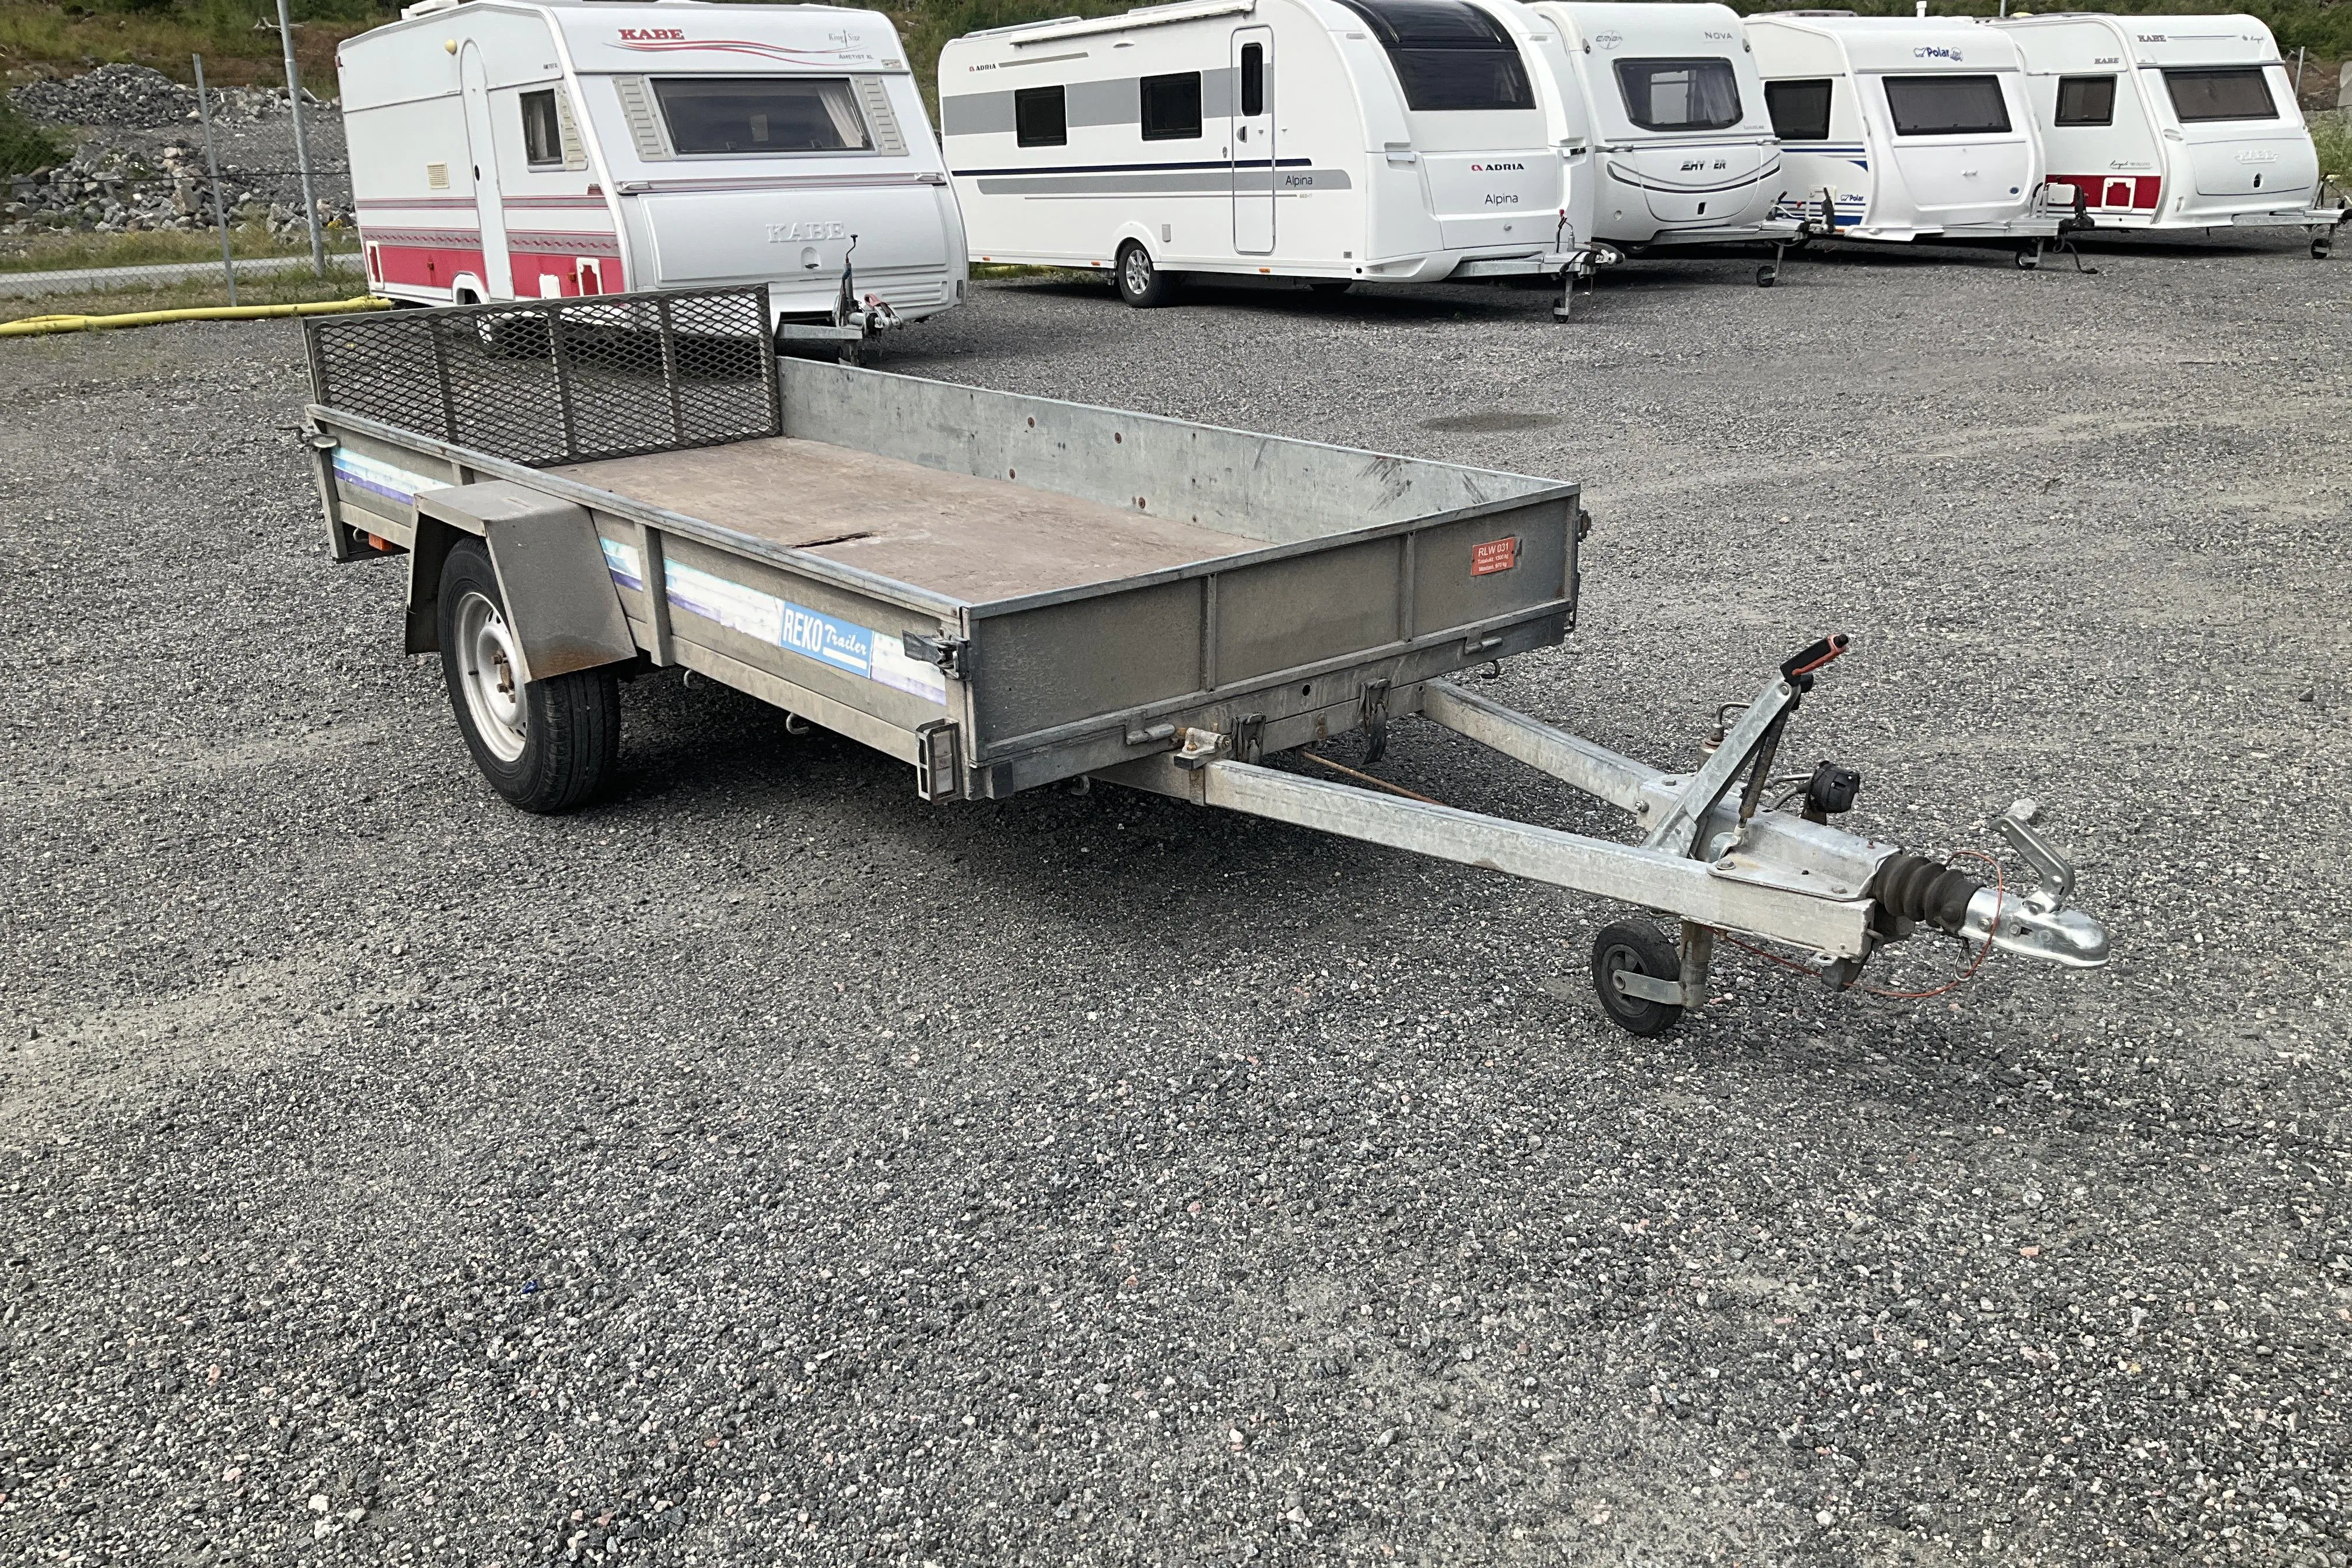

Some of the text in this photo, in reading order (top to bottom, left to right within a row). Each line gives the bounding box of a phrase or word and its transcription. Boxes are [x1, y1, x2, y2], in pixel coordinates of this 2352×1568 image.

[618, 29, 685, 40] KABE
[828, 33, 860, 43] King Size
[1927, 47, 1950, 57] Polar
[1285, 174, 1312, 188] Alpina
[1485, 193, 1518, 206] Alpina
[765, 222, 846, 243] KABE
[1478, 542, 1508, 557] RLW 031
[783, 608, 867, 656] REKO Trailer
